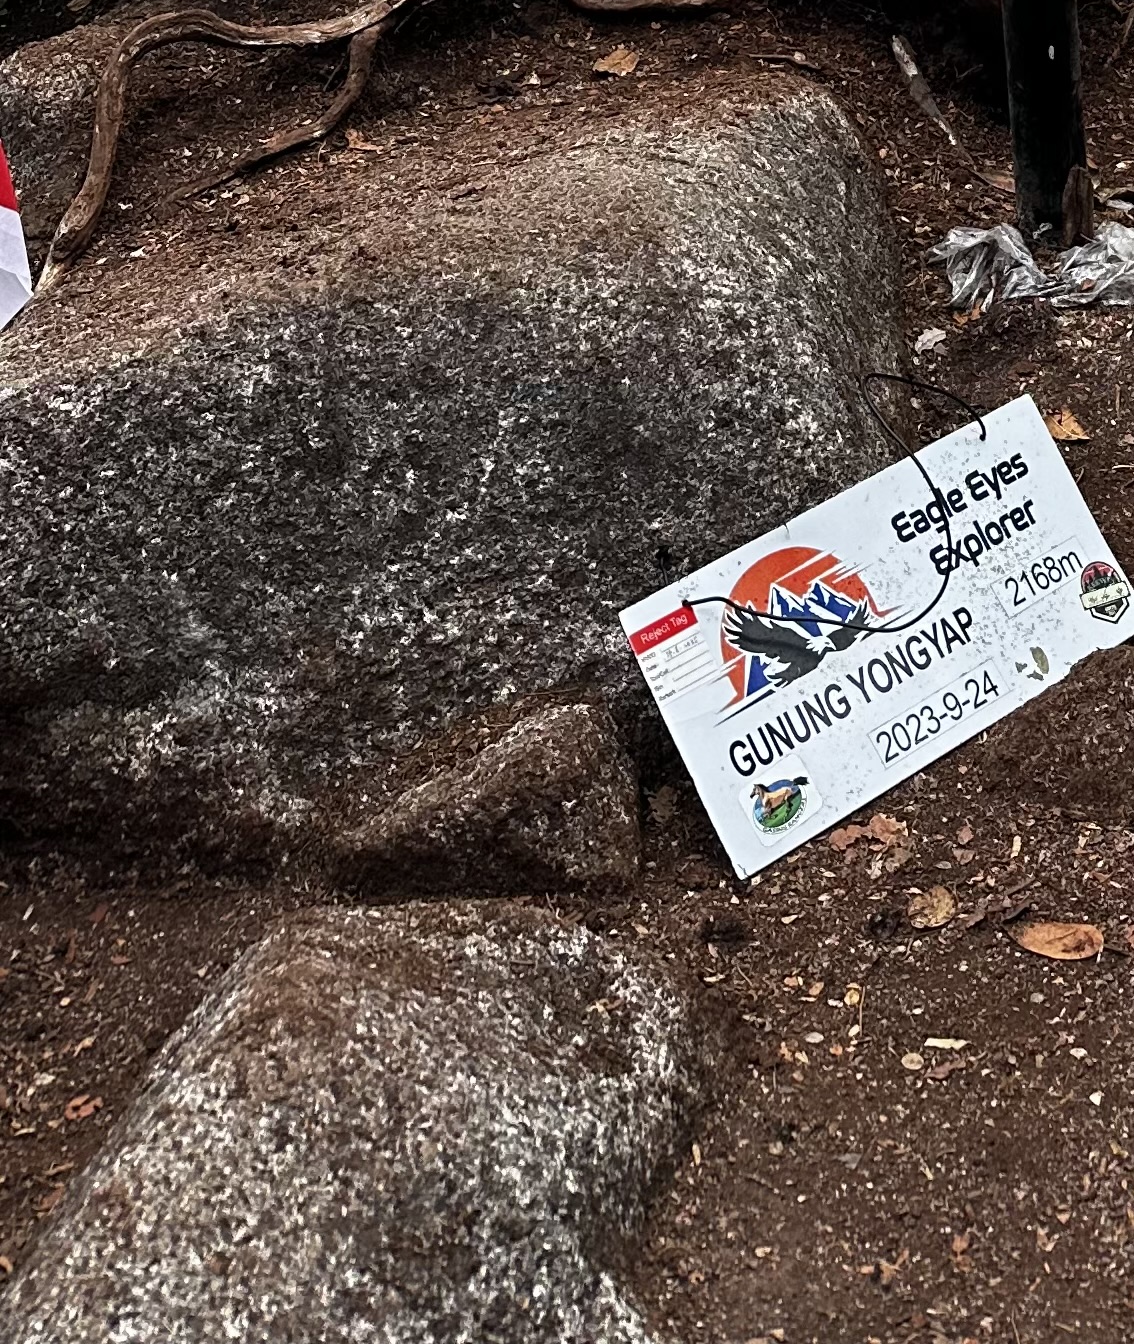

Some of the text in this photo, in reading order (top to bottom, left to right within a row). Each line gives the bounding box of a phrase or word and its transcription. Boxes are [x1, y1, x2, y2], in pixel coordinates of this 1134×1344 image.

[891, 452, 1029, 543] Eagle Eyes
[929, 499, 1036, 576] Explorer
[1004, 551, 1084, 607] 2168m
[640, 614, 688, 645] Reject Tag
[729, 606, 973, 777] GUNUNG YONGYAP
[876, 670, 1000, 763] 2023-9-24
